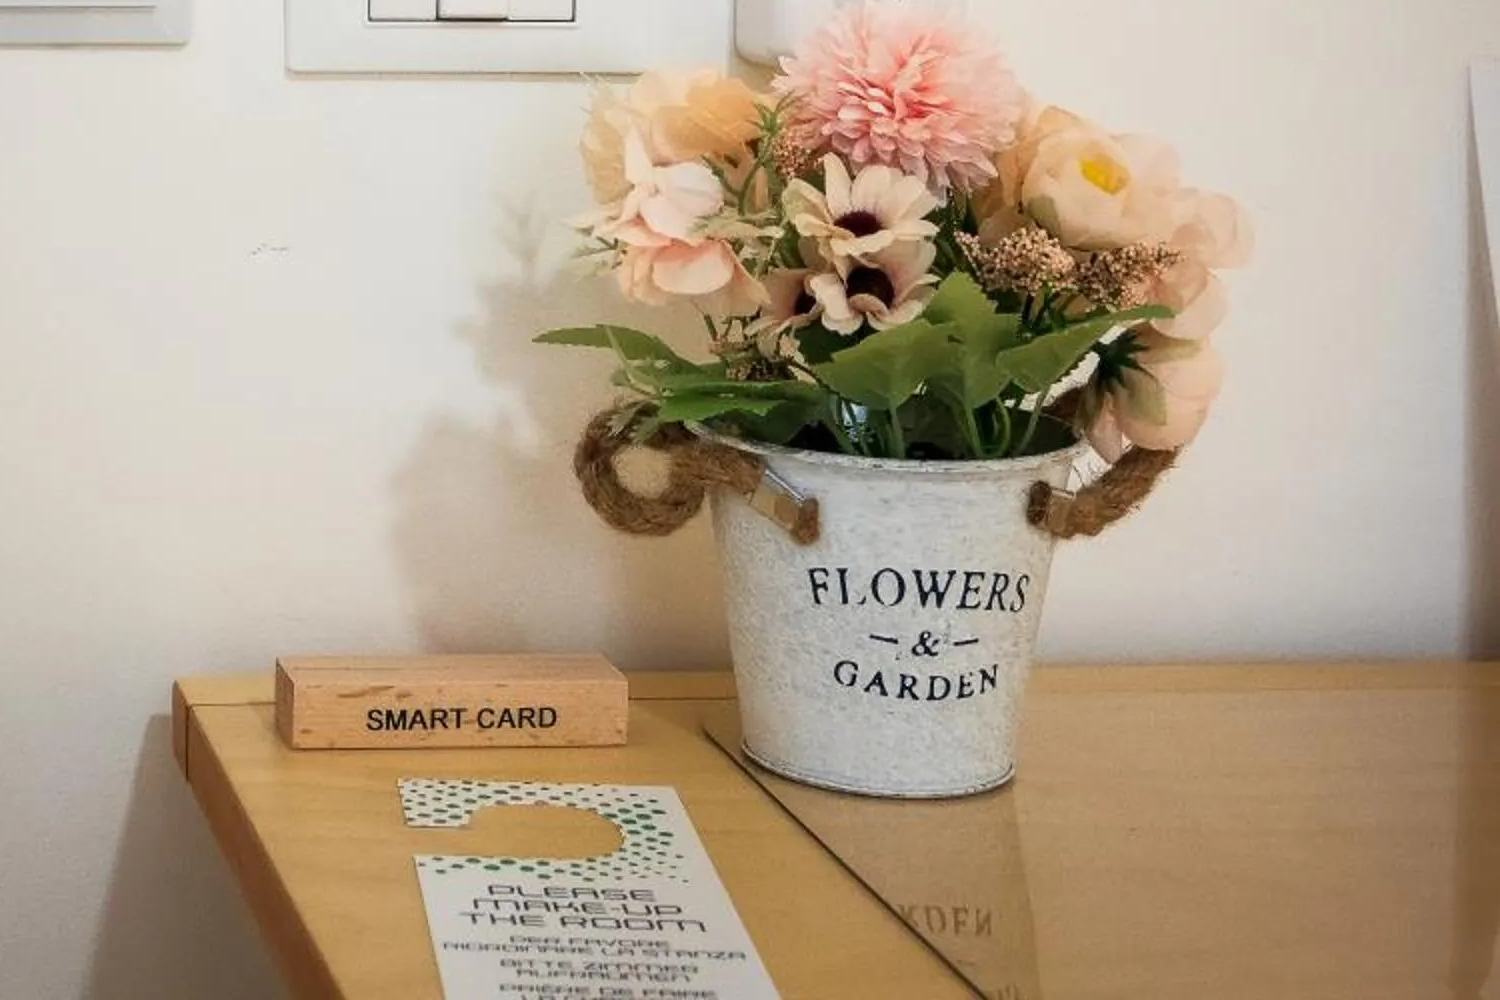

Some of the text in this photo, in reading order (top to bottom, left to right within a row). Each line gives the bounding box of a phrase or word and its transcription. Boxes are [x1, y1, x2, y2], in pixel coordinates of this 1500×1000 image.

[808, 567, 1030, 612] FLOWERS
[911, 631, 940, 657] &
[833, 660, 1000, 701] GARDEN
[366, 707, 557, 732] SMART CARD
[488, 884, 654, 901] PLEASE
[473, 898, 682, 916] MAKE-UP
[459, 911, 706, 932] THE ROOM
